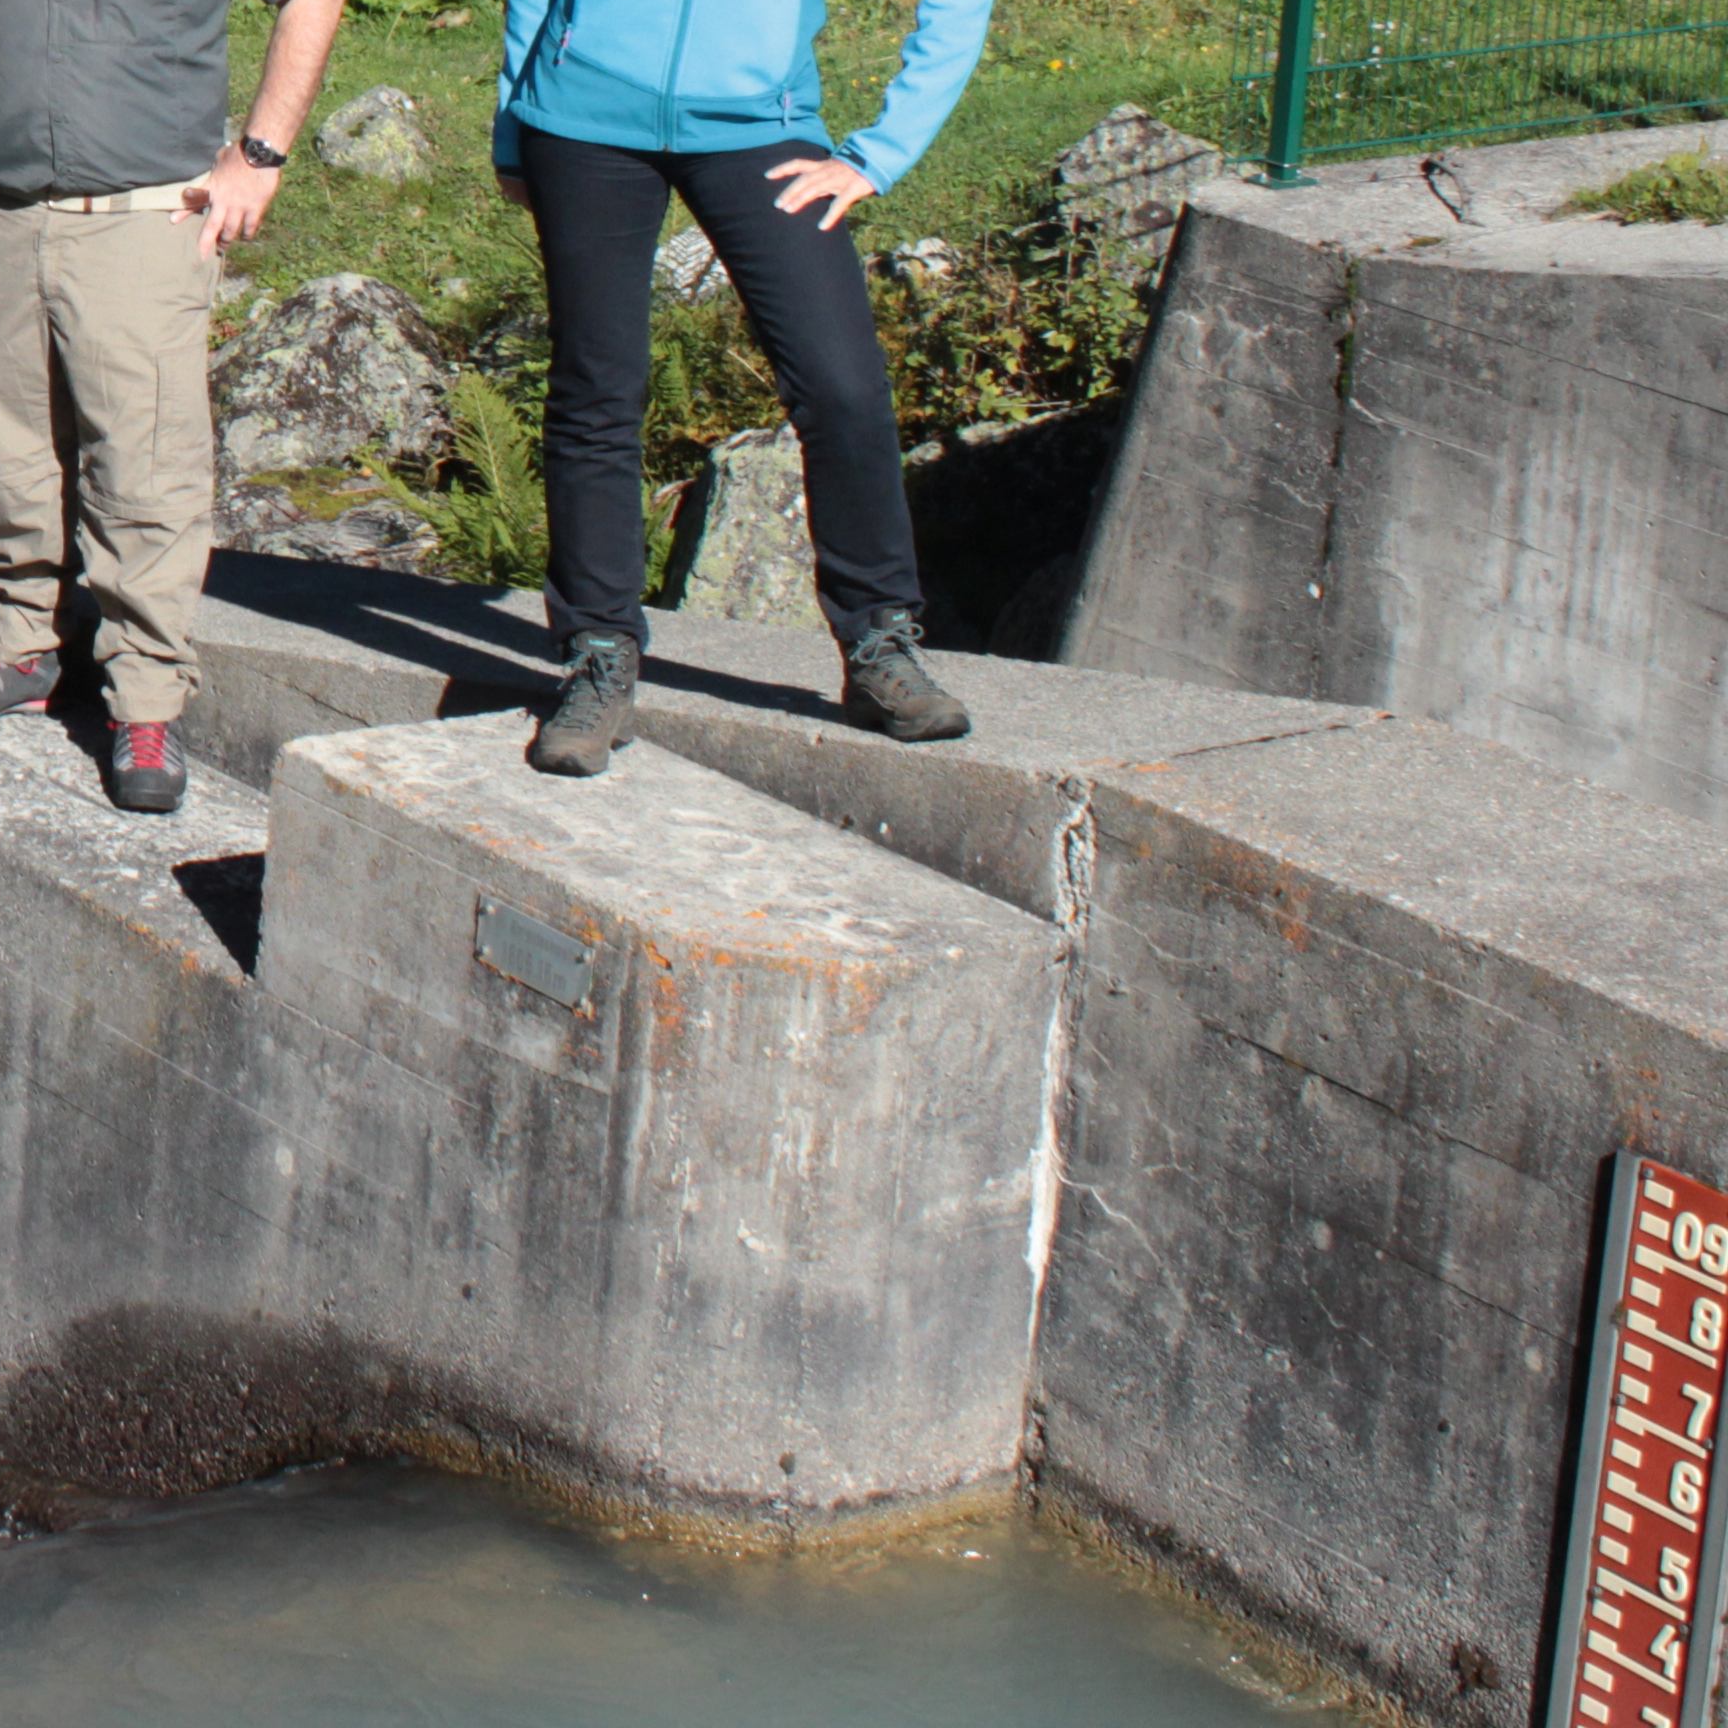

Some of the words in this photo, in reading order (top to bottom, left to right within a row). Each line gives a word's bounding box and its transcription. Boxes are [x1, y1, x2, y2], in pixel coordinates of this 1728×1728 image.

[1673, 1211, 1728, 1276] 09
[1690, 1297, 1723, 1351] 8
[1682, 1383, 1713, 1440] 7
[1670, 1460, 1703, 1514] 6
[1659, 1546, 1691, 1602] 5
[1650, 1624, 1680, 1680] 4
